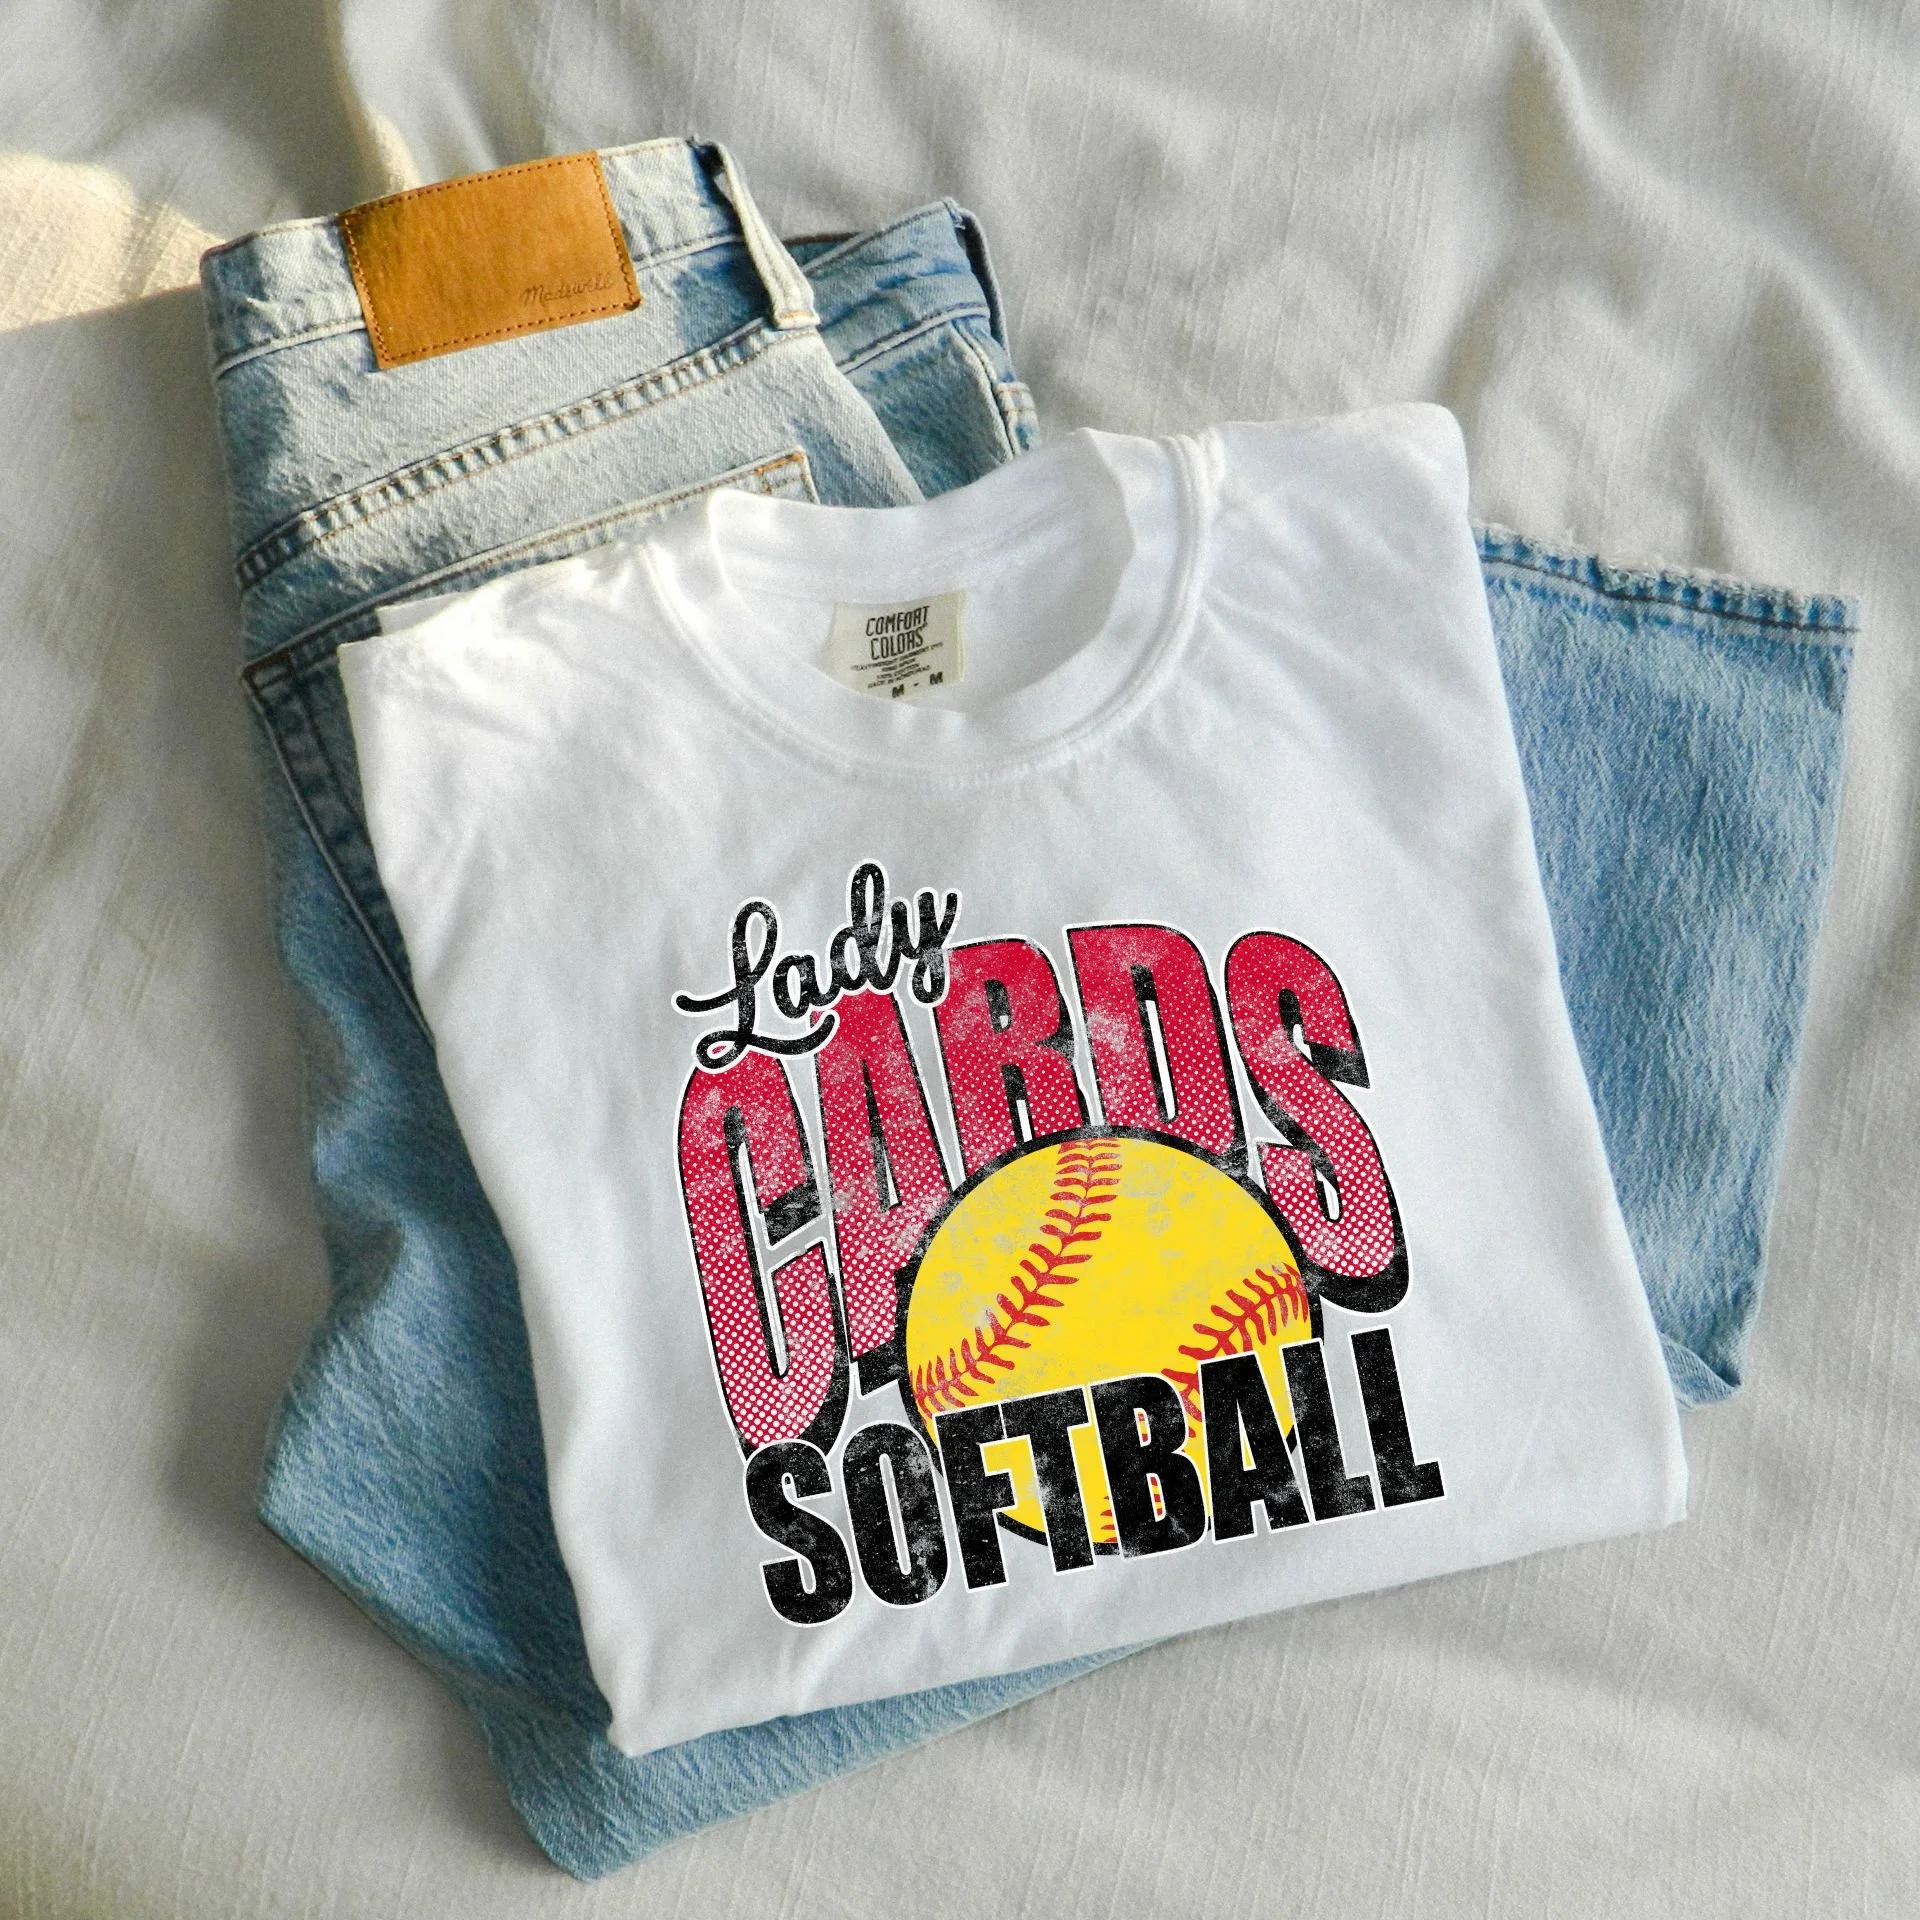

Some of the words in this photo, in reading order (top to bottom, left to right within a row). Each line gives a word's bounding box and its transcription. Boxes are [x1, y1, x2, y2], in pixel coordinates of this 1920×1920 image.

[521, 272, 615, 305] Madewell
[865, 606, 930, 636] COMFORT
[870, 627, 924, 660] COLORS
[929, 672, 943, 685] M
[676, 863, 958, 1069] Lady
[678, 924, 1409, 1459] CARDS
[746, 1328, 1444, 1624] SOFTBALL
